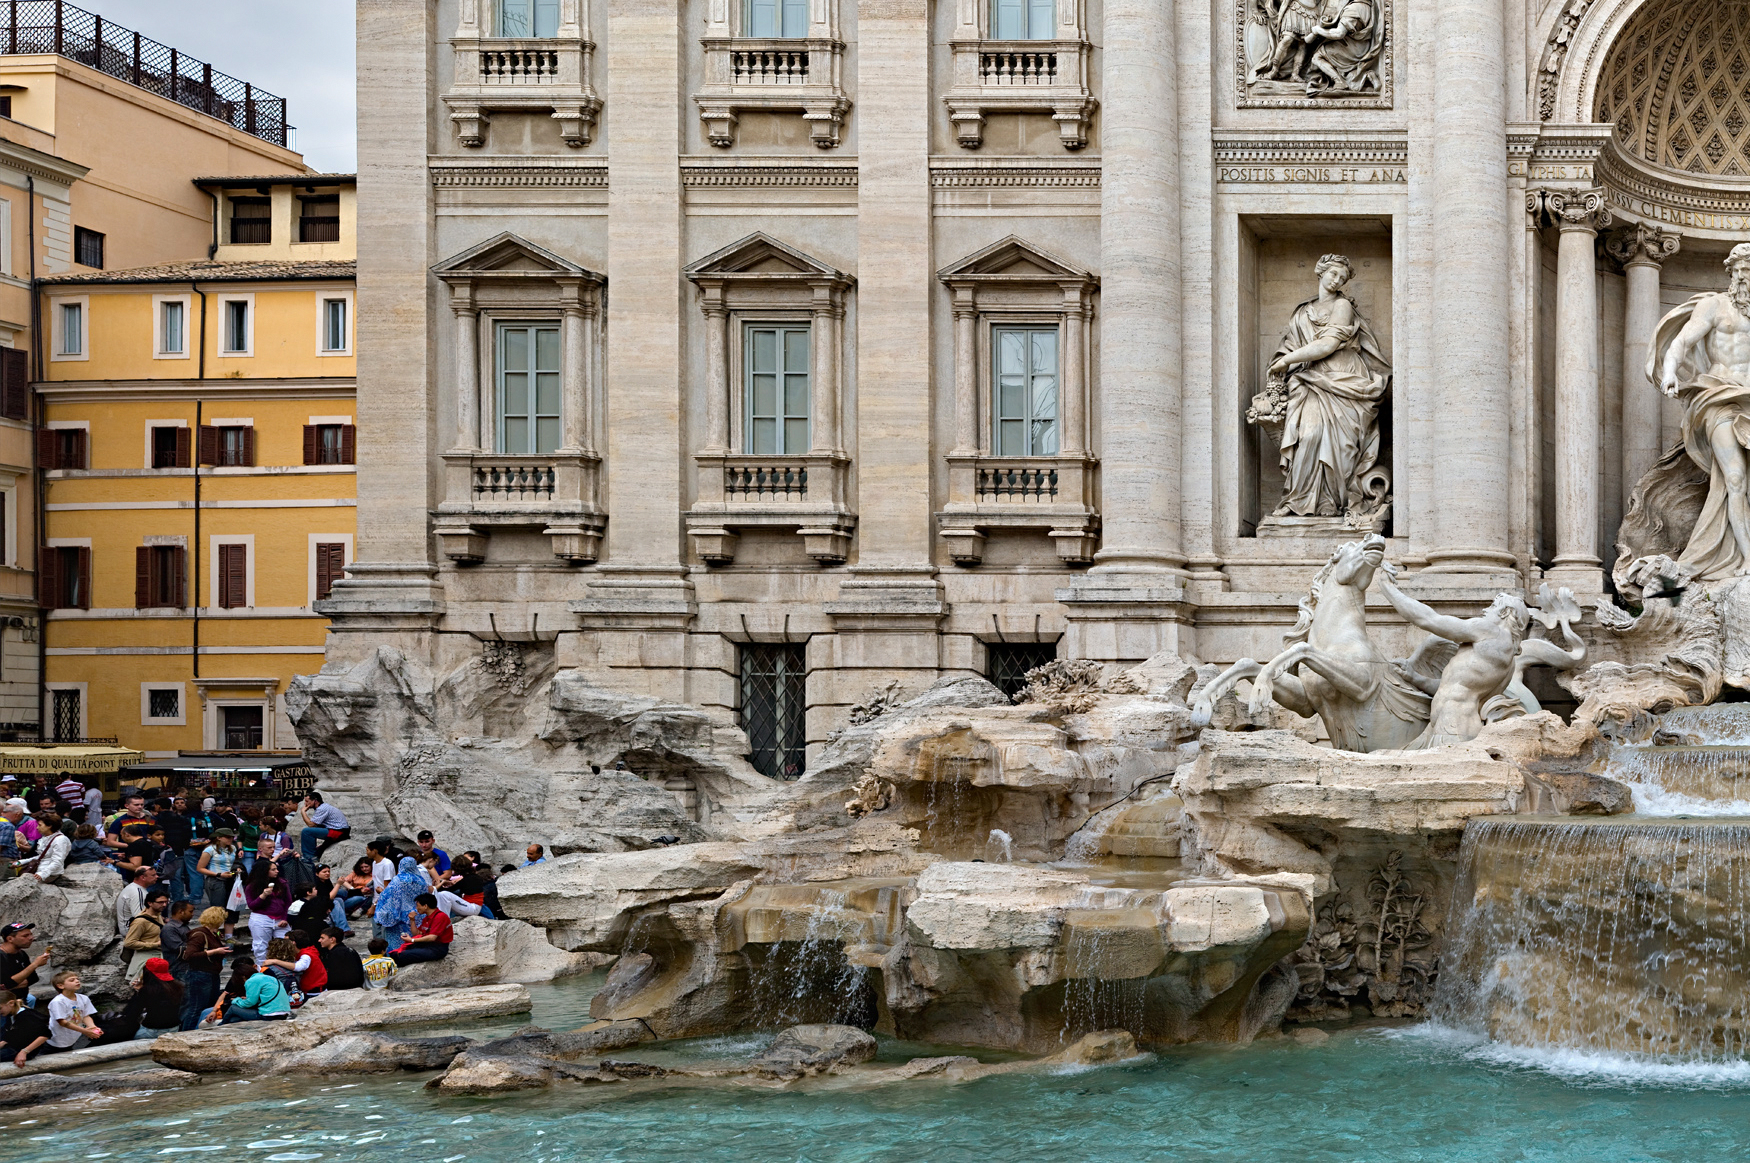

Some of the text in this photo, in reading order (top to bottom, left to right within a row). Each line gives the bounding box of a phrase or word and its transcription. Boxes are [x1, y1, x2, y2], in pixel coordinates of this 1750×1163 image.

[1220, 168, 1275, 182] POSITIS
[1283, 168, 1330, 182] SIGNIS
[1341, 168, 1358, 182] ET
[3, 758, 35, 768] FRUTTA
[40, 758, 48, 768] DI
[88, 760, 115, 768] POINT
